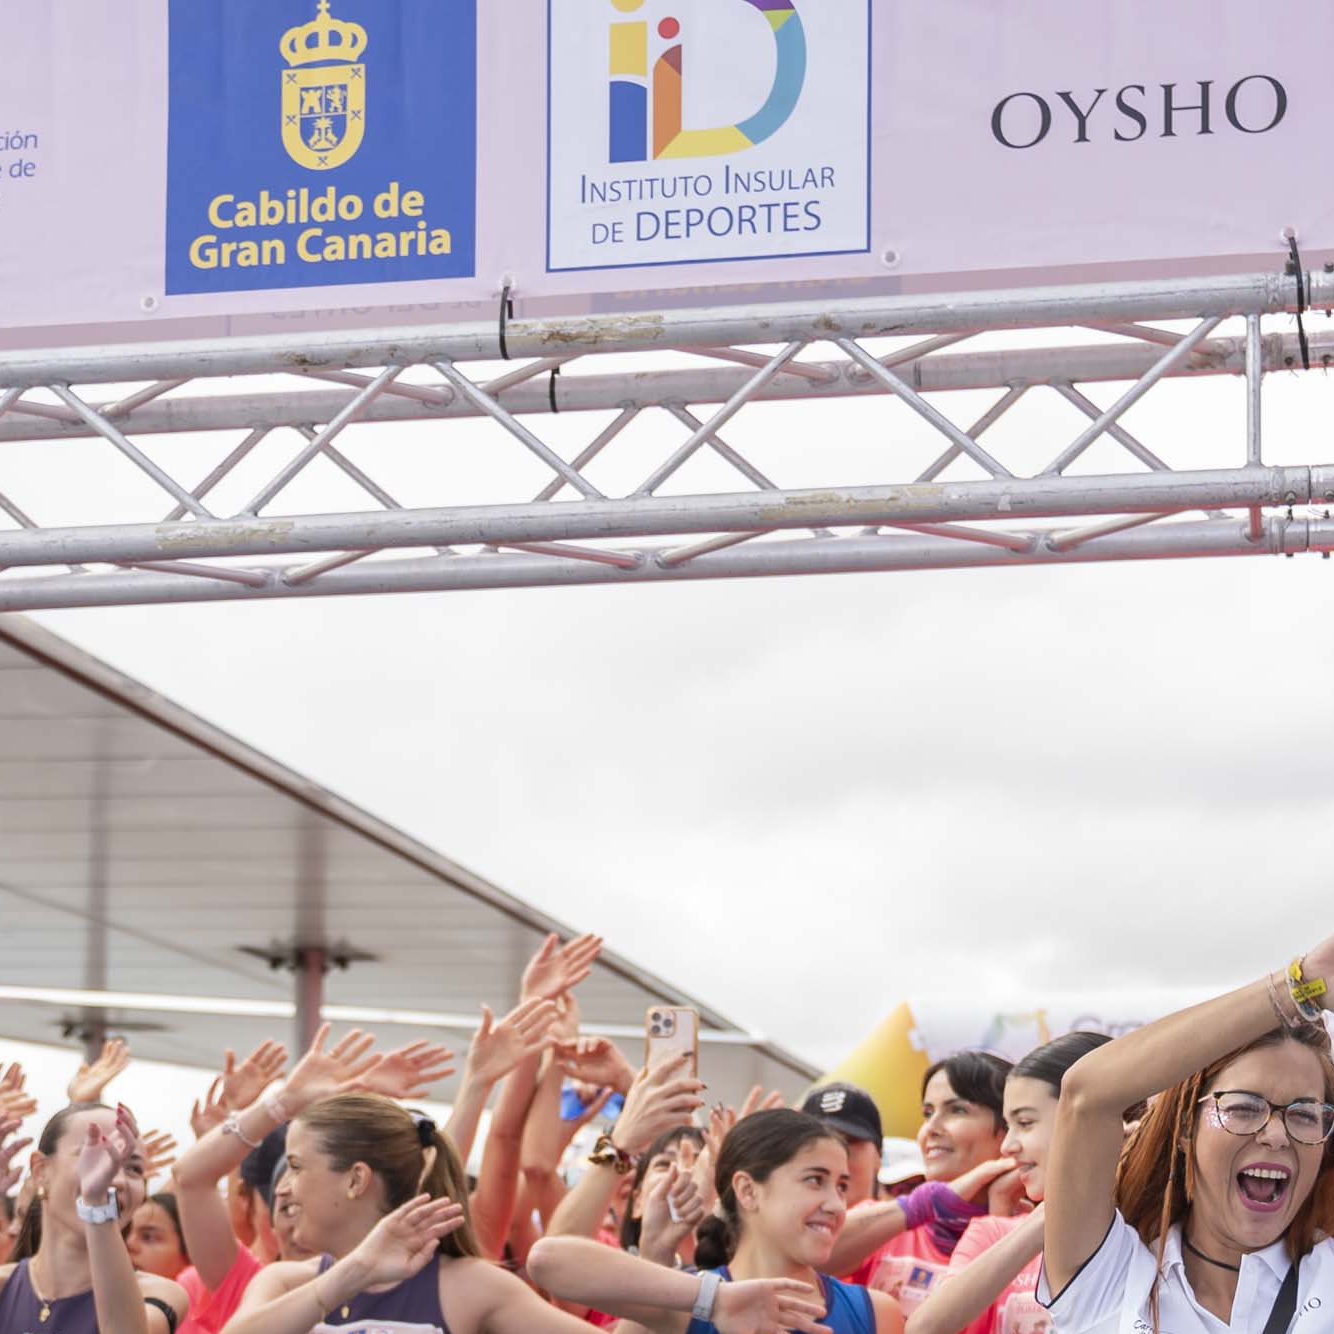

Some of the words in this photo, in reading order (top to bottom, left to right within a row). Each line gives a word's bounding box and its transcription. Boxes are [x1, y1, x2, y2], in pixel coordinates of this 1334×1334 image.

[990, 74, 1288, 149] OYSHO
[9, 158, 36, 180] de
[580, 172, 714, 205] INSTITUTO
[724, 163, 836, 195] INSULAR
[208, 186, 365, 231] Cabildo
[373, 181, 426, 219] de
[591, 222, 625, 245] DE
[636, 200, 823, 244] DEPORTES
[188, 231, 288, 270] Gran
[295, 222, 453, 265] Canaria
